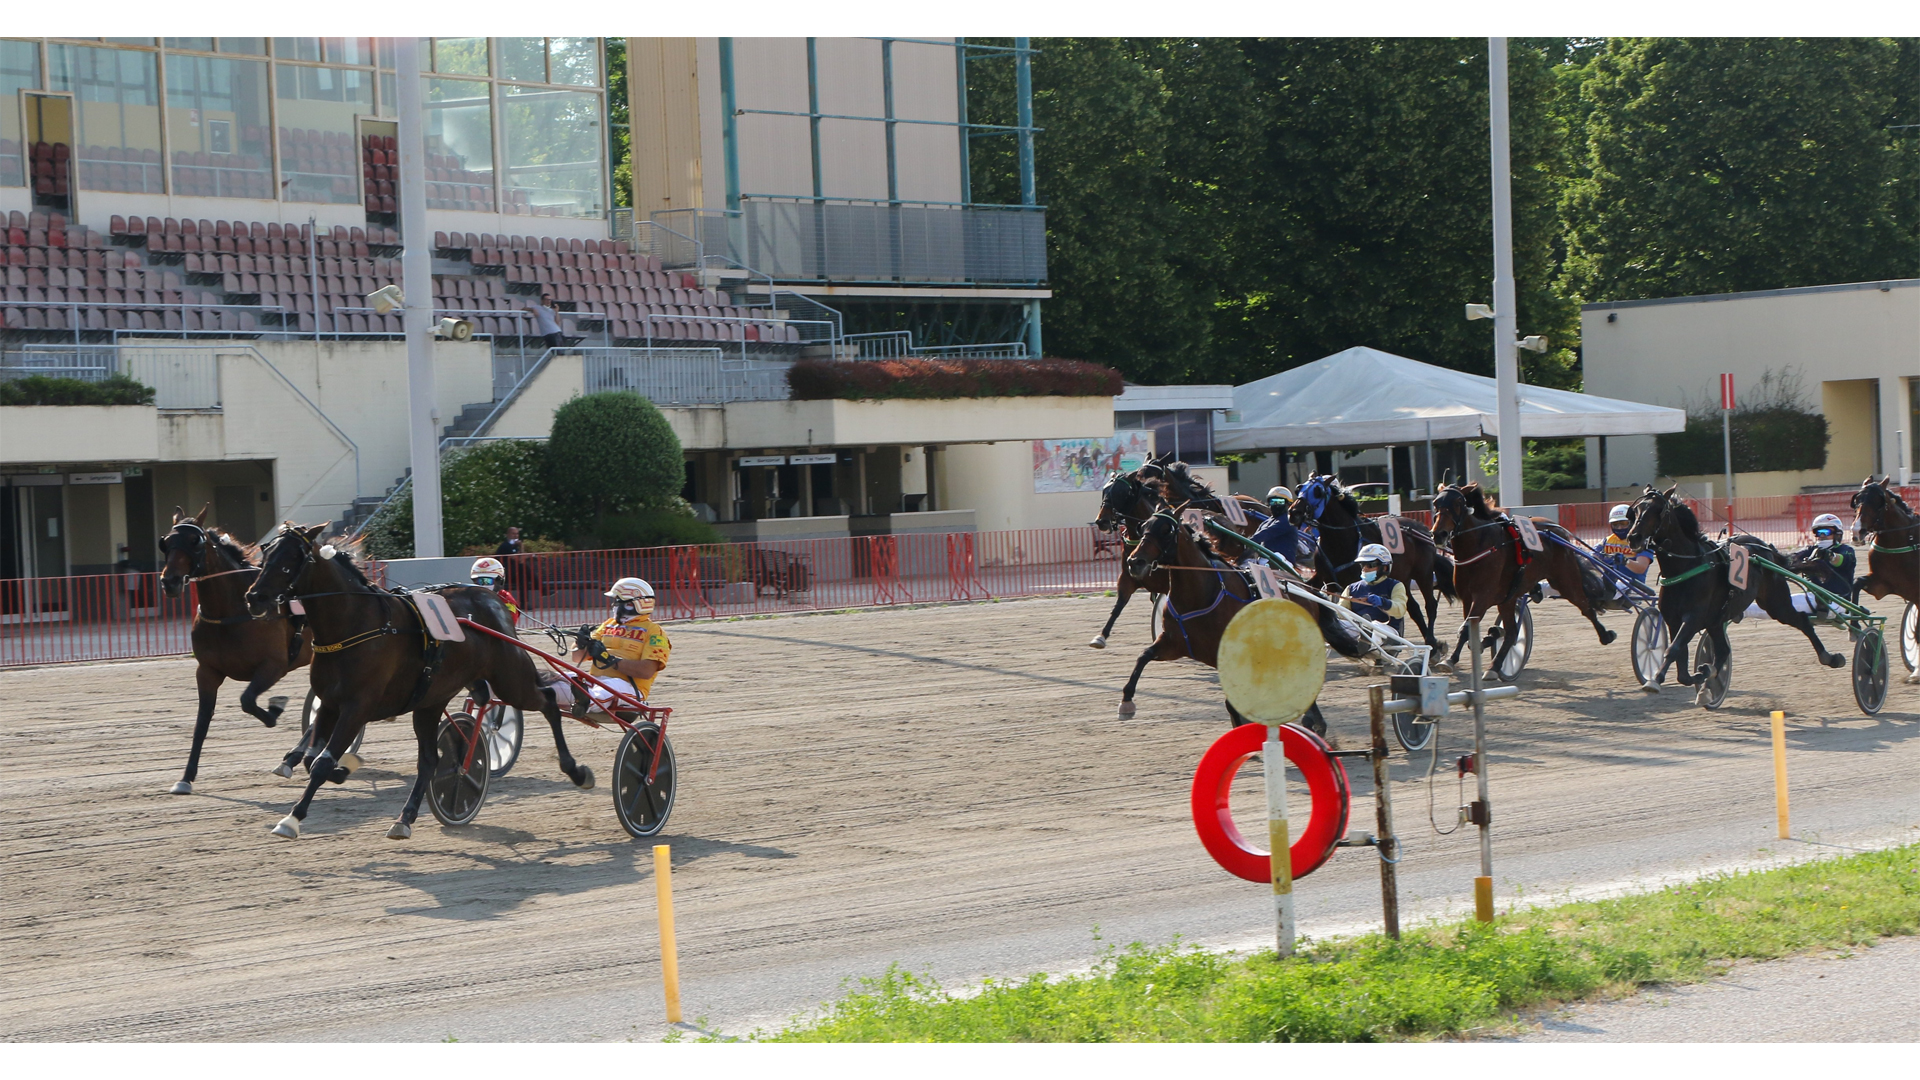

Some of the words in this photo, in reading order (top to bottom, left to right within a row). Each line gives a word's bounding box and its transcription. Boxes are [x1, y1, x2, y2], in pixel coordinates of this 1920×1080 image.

[1224, 499, 1244, 522] 11
[1385, 522, 1398, 549] 9
[1520, 519, 1537, 546] 5
[1733, 550, 1744, 584] 2
[1260, 569, 1275, 597] 4
[427, 599, 450, 635] 1
